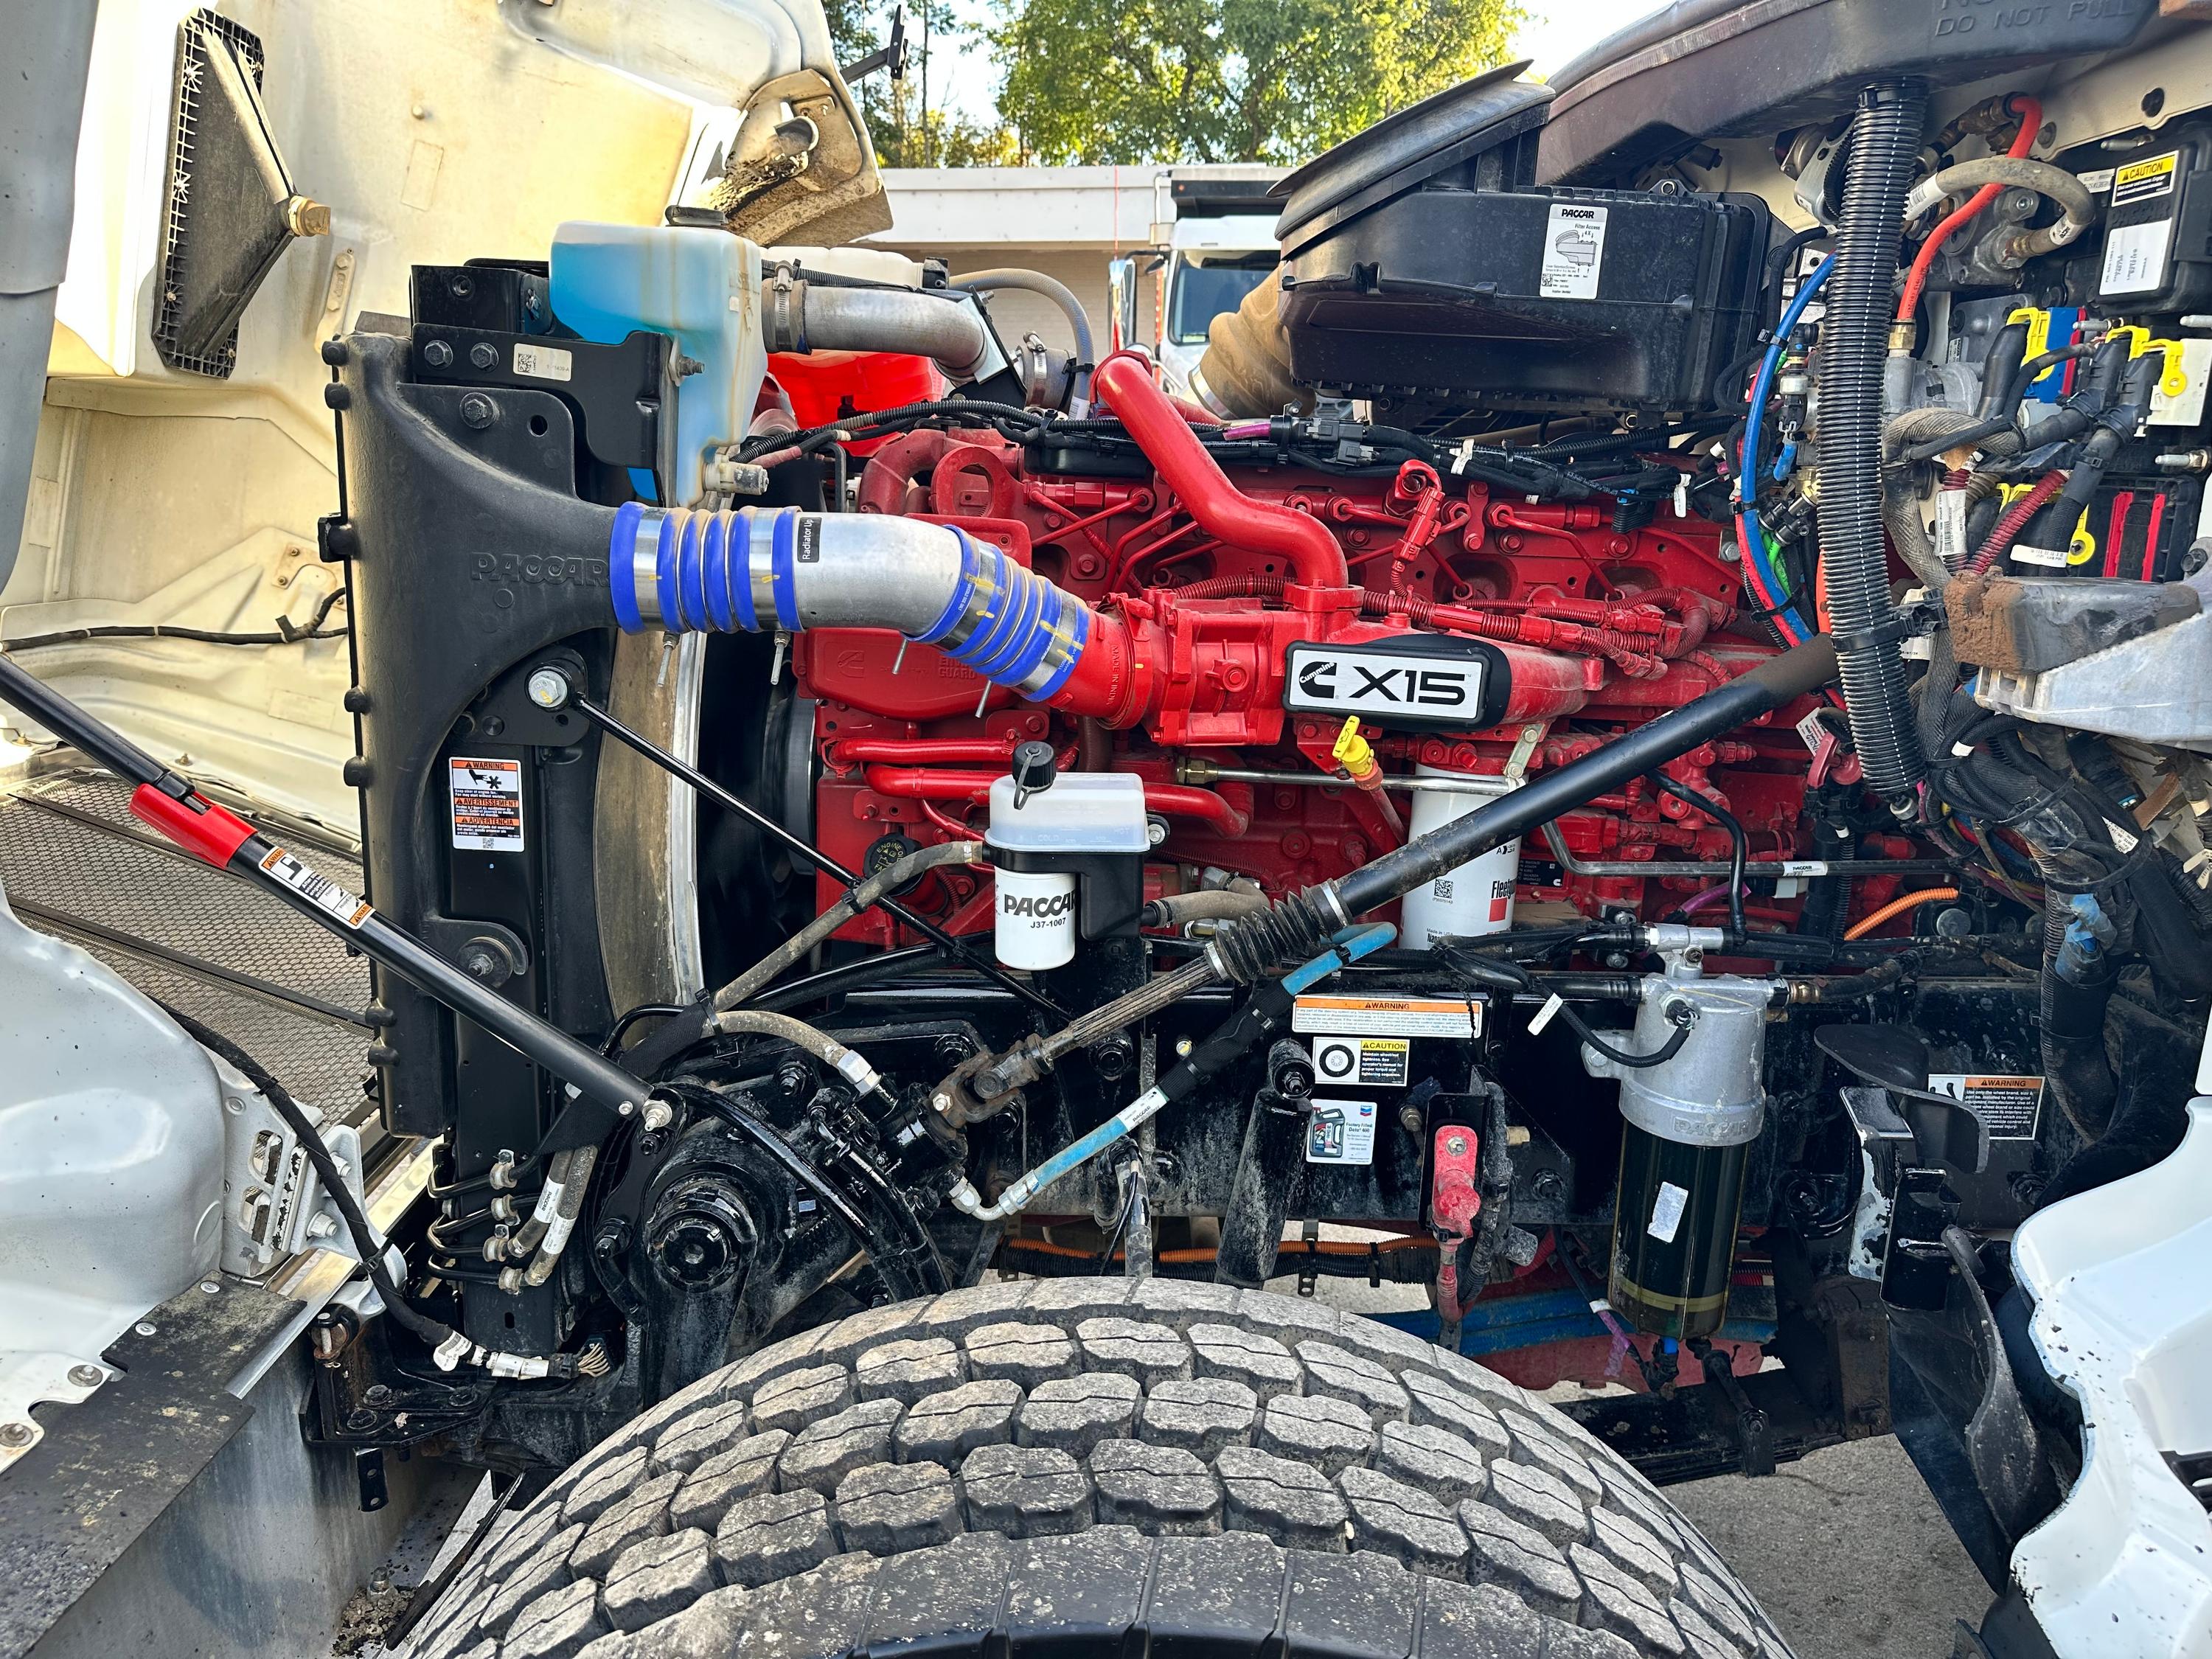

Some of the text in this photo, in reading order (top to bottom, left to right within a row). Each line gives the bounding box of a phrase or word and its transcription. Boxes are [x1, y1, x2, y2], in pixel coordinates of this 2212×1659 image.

[1935, 0, 2135, 36] DO NOT PULL
[2129, 161, 2163, 178] CAUTION
[1561, 209, 1594, 219] PACCAR
[802, 519, 814, 560] Radiator Up
[472, 552, 611, 587] PACCAR
[938, 667, 976, 680] GUARD
[1112, 674, 1119, 683] IN
[1299, 661, 1335, 684] Cummins
[1349, 666, 1466, 706] X15
[1106, 685, 1117, 705] INDIA
[877, 842, 902, 853] ENGINE
[1030, 917, 1066, 928] J37-1007
[1133, 1106, 1151, 1122] PACCAR
